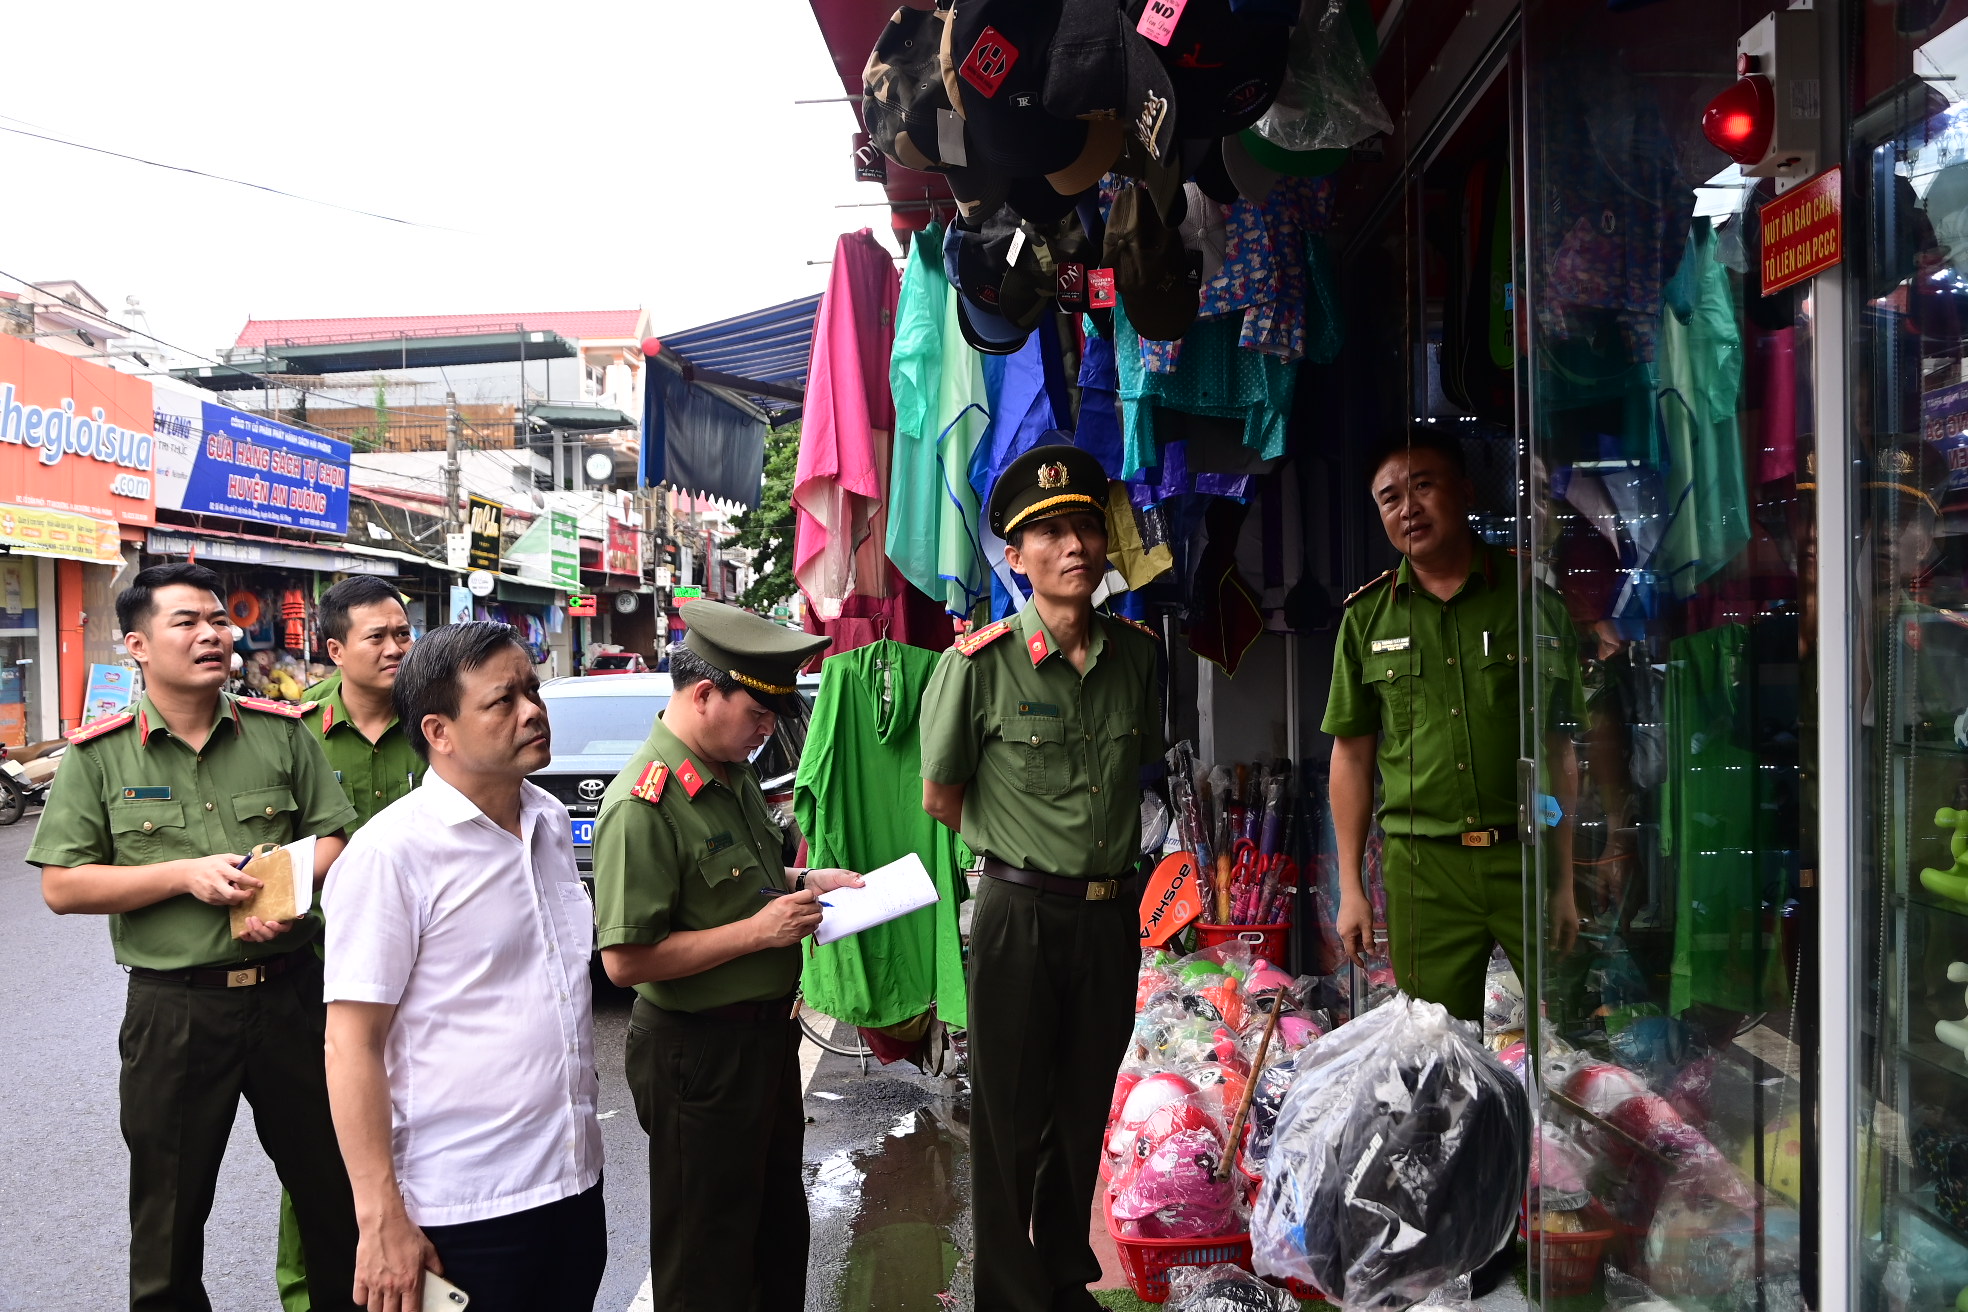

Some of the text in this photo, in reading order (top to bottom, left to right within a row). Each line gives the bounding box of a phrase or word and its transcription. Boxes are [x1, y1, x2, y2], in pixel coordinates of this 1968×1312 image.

[1151, 1, 1175, 19] ND
[1765, 216, 1779, 247] NÚT
[1795, 200, 1811, 231] BÁO
[1766, 228, 1836, 282] TỔ LIÊN GIA PCCC
[0, 382, 153, 470] hegioisua
[110, 473, 151, 499] .com
[207, 430, 346, 492] CỬA HÀNG SÁCH TỰ CHỌN
[227, 473, 270, 508] HUYỆN
[270, 483, 289, 508] AN
[289, 487, 327, 515] DƯƠNG
[1140, 864, 1191, 939] BOSHIKA
[1344, 1132, 1383, 1207] BASECAMP
